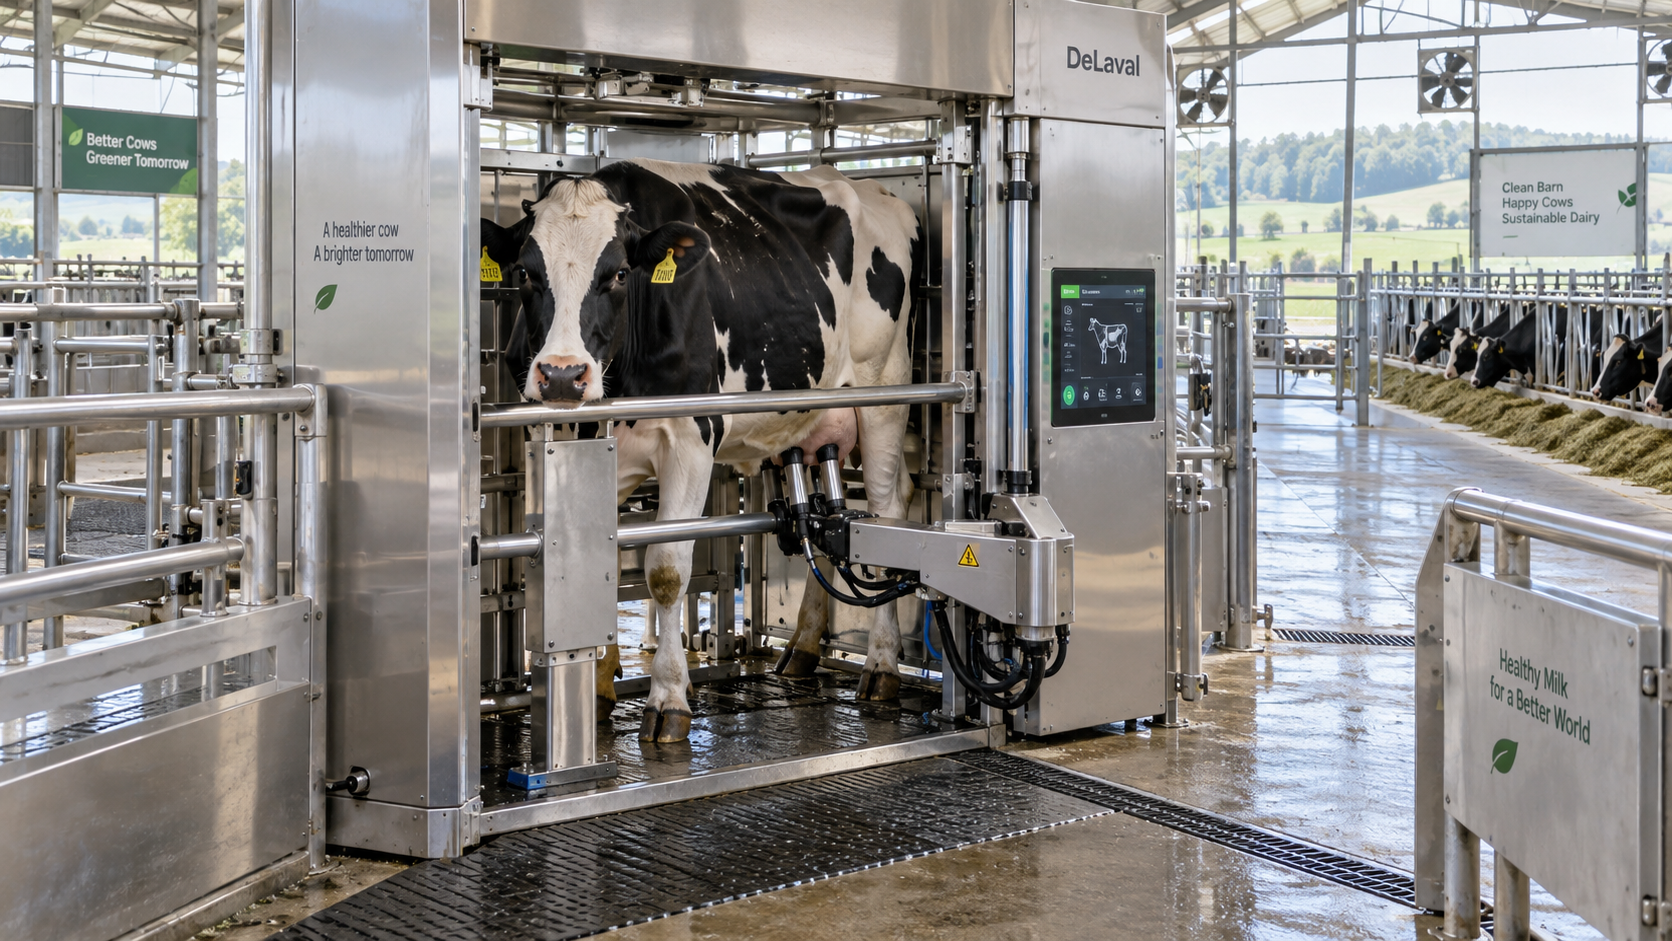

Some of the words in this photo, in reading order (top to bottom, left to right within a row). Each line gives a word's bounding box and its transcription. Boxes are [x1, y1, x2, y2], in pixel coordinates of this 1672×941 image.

[1067, 46, 1140, 77] DeLaval
[86, 132, 124, 148] Better
[126, 135, 157, 150] Cows
[86, 150, 133, 166] Greener
[134, 153, 189, 170] Tomorrow
[1502, 182, 1534, 193] Clean
[1537, 181, 1563, 192] Barn
[1502, 197, 1539, 210] Happy
[1542, 196, 1573, 208] Cows
[1502, 212, 1567, 224] Sustainable
[1570, 211, 1600, 225] Dairy
[323, 221, 330, 238] A
[332, 220, 376, 238] healthier
[378, 224, 399, 237] cow
[313, 245, 321, 261] A
[324, 244, 363, 266] brighter
[364, 245, 414, 262] tomorrow
[1500, 648, 1541, 691] Healthy
[1544, 667, 1568, 699] Milk
[1490, 675, 1505, 702] for
[1507, 689, 1514, 707] a
[1516, 688, 1551, 724] Better
[1554, 704, 1590, 745] World
